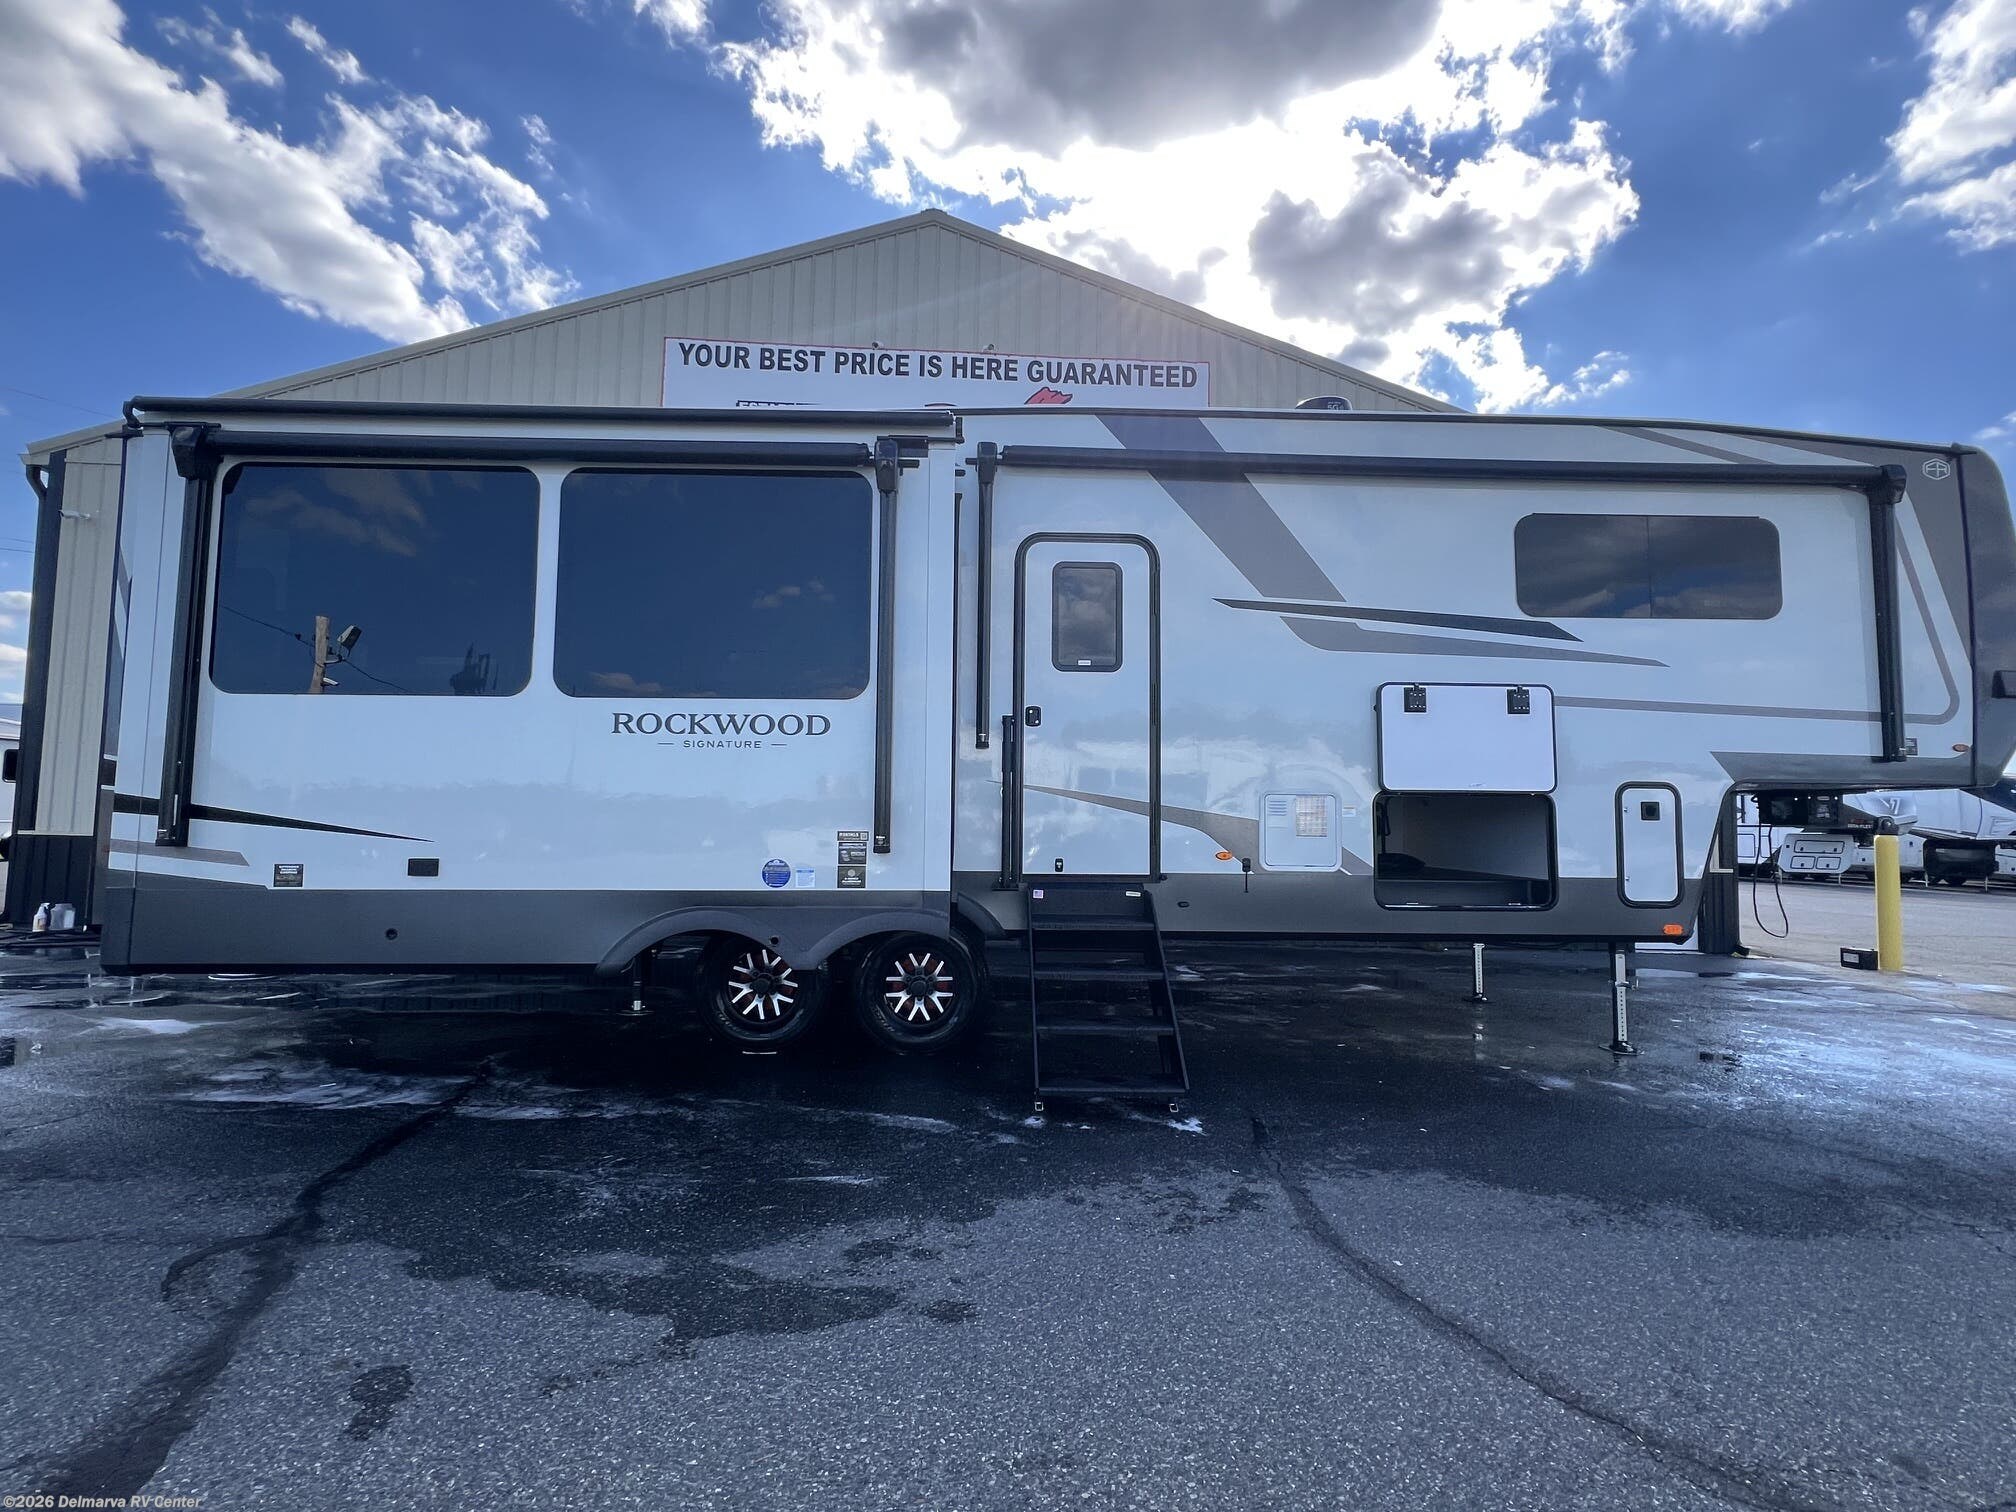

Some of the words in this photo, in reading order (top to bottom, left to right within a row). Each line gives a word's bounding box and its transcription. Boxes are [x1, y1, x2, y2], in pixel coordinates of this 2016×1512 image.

[678, 342, 751, 369] YOUR
[759, 347, 826, 373] BEST
[834, 351, 910, 377] PRICE
[919, 354, 943, 378] IS
[951, 356, 1019, 382] HERE
[1026, 360, 1198, 389] GUARANTEED
[611, 712, 831, 736] ROCKWOOD
[683, 740, 762, 749] SIGNATURE
